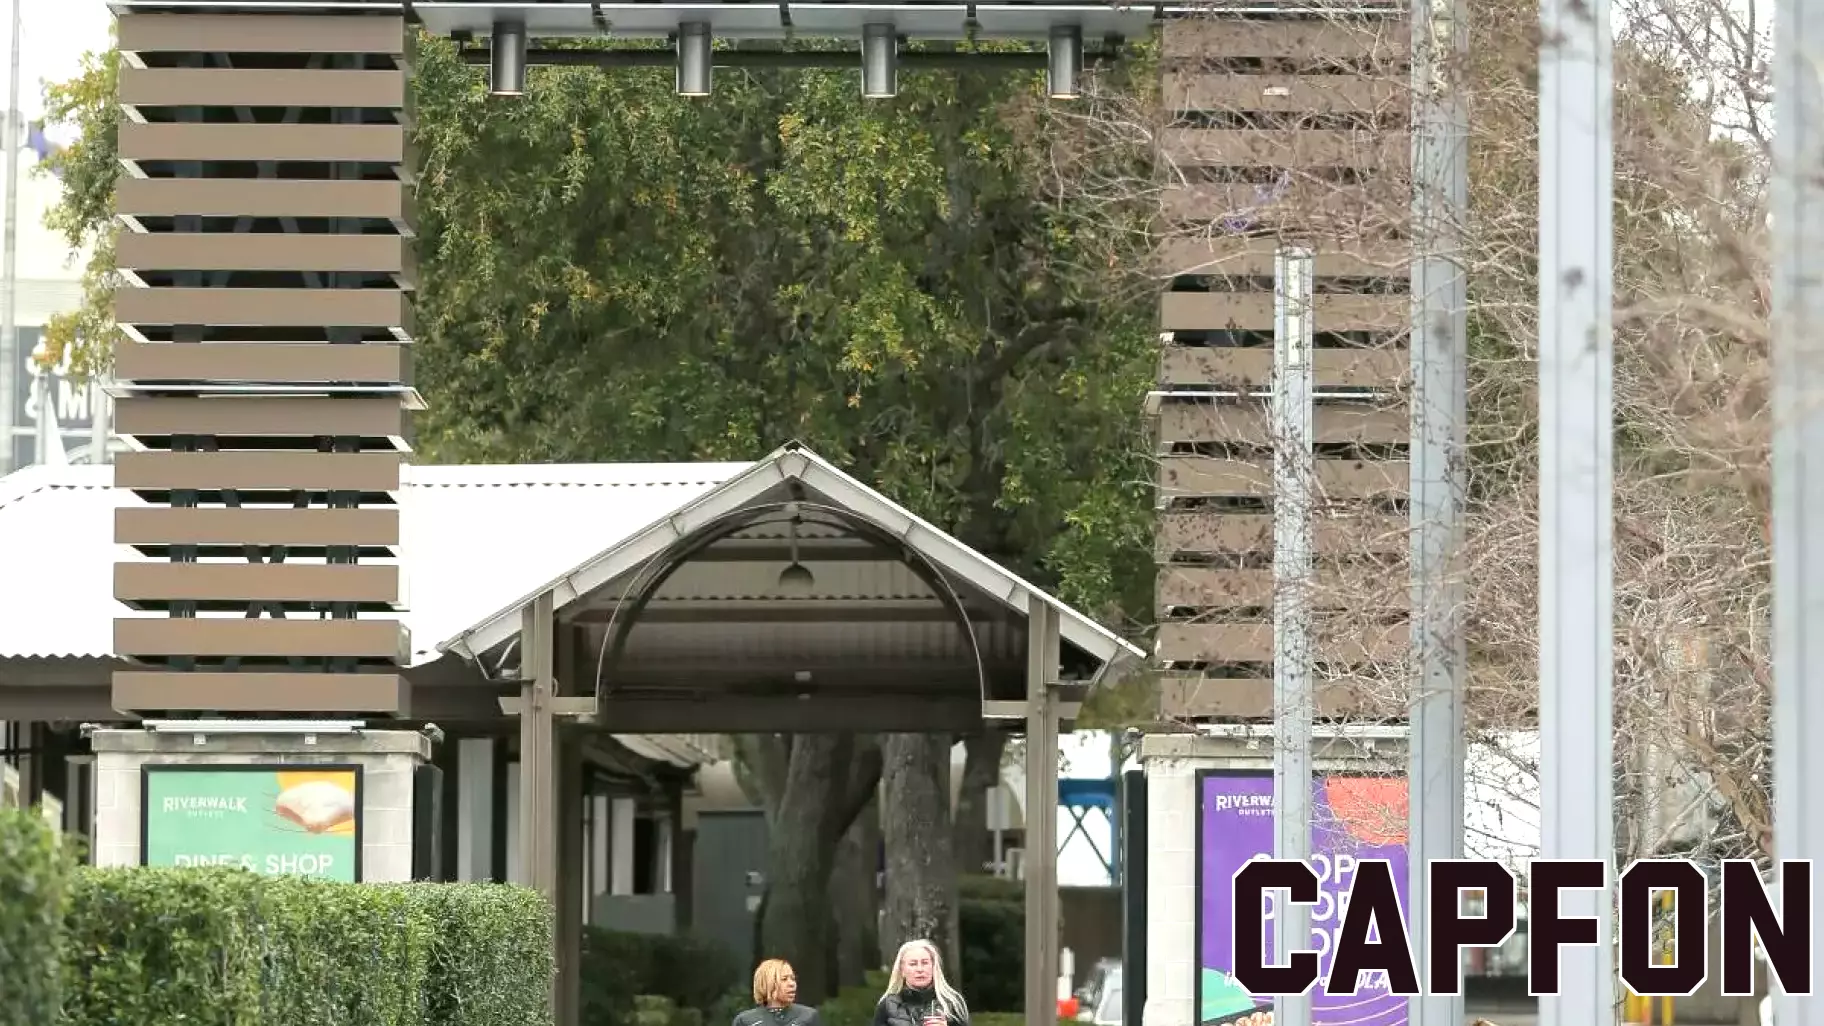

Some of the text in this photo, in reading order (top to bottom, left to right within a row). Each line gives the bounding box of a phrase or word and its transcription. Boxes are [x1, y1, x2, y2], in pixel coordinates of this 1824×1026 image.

[163, 796, 248, 813] RIVERWALK
[1216, 795, 1274, 812] RIVERW
[265, 853, 333, 874] SHOP
